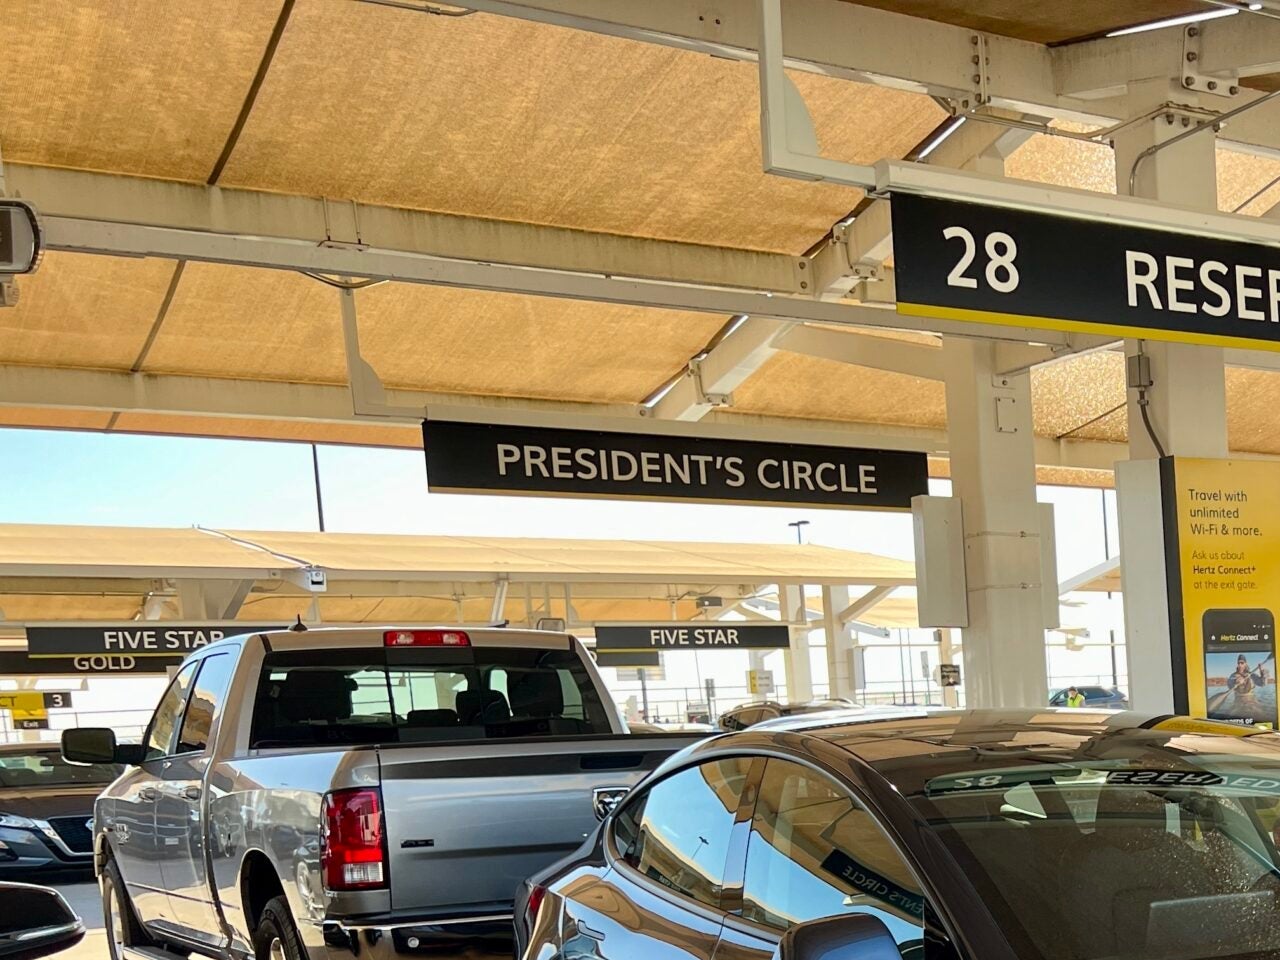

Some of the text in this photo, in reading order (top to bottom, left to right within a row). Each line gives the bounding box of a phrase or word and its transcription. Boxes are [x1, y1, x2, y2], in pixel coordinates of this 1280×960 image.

[943, 226, 1020, 293] 28
[496, 443, 878, 494] PRESIDENT'S CIRCLE
[1188, 489, 1247, 502] Travel with
[1190, 507, 1239, 519] unlimited
[1190, 523, 1263, 536] Wi-Fi & more.
[1192, 550, 1244, 560] Ask us about
[1193, 565, 1215, 574] Hertz
[1194, 581, 1203, 589] at
[1205, 580, 1218, 589] the
[1220, 581, 1235, 590] exit
[103, 631, 157, 649] FIVE
[650, 629, 739, 645] FIVE STAR
[73, 655, 136, 671] GOLD
[52, 694, 63, 707] 3
